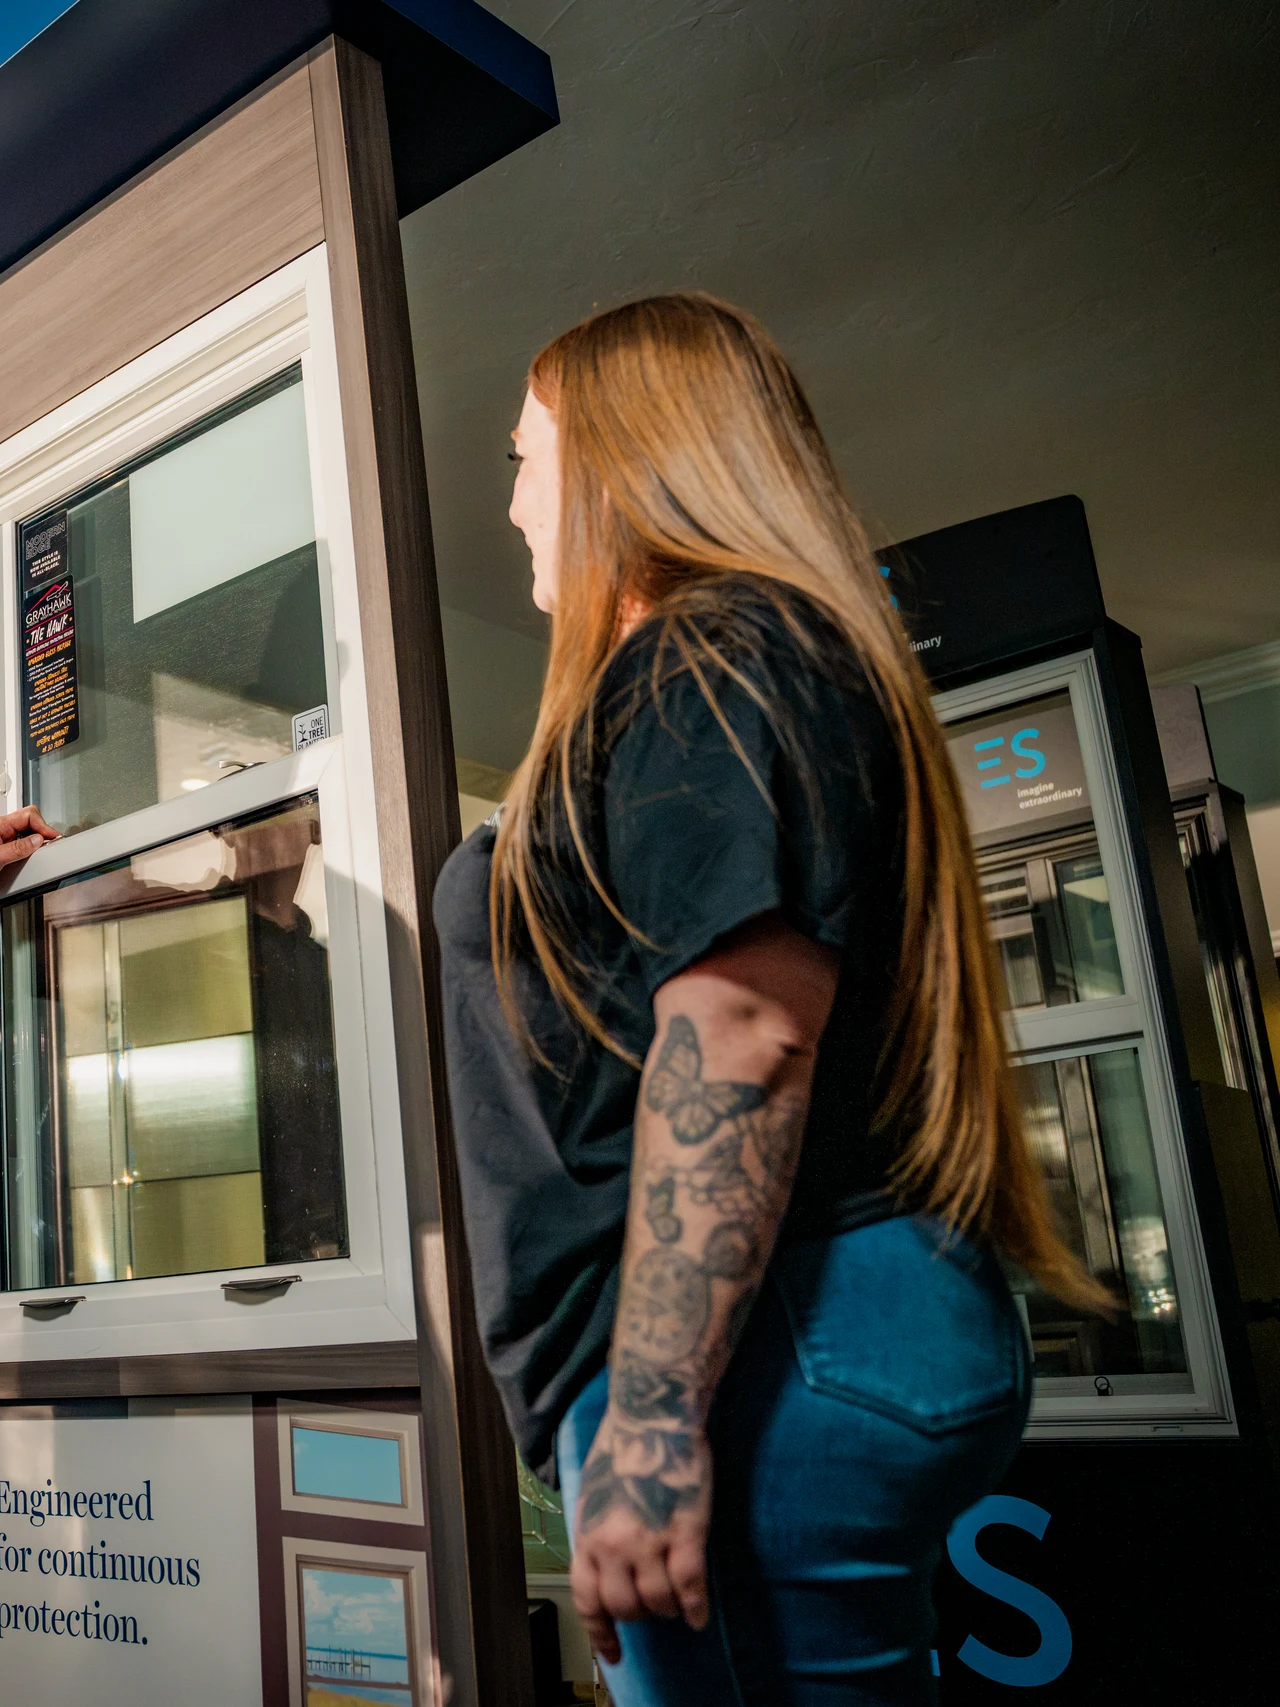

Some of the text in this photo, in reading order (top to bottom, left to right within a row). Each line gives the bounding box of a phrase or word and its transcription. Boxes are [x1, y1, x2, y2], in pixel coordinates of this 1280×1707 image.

[26, 592, 72, 625] GRAYHAWK
[31, 626, 45, 647] THE
[46, 613, 69, 639] HAWK
[309, 726, 324, 739] TREE
[311, 716, 324, 729] ONE
[974, 728, 1046, 789] ES
[1017, 781, 1055, 798] imagine
[1019, 787, 1083, 810] extraordinary
[38, 1540, 201, 1587] continuous
